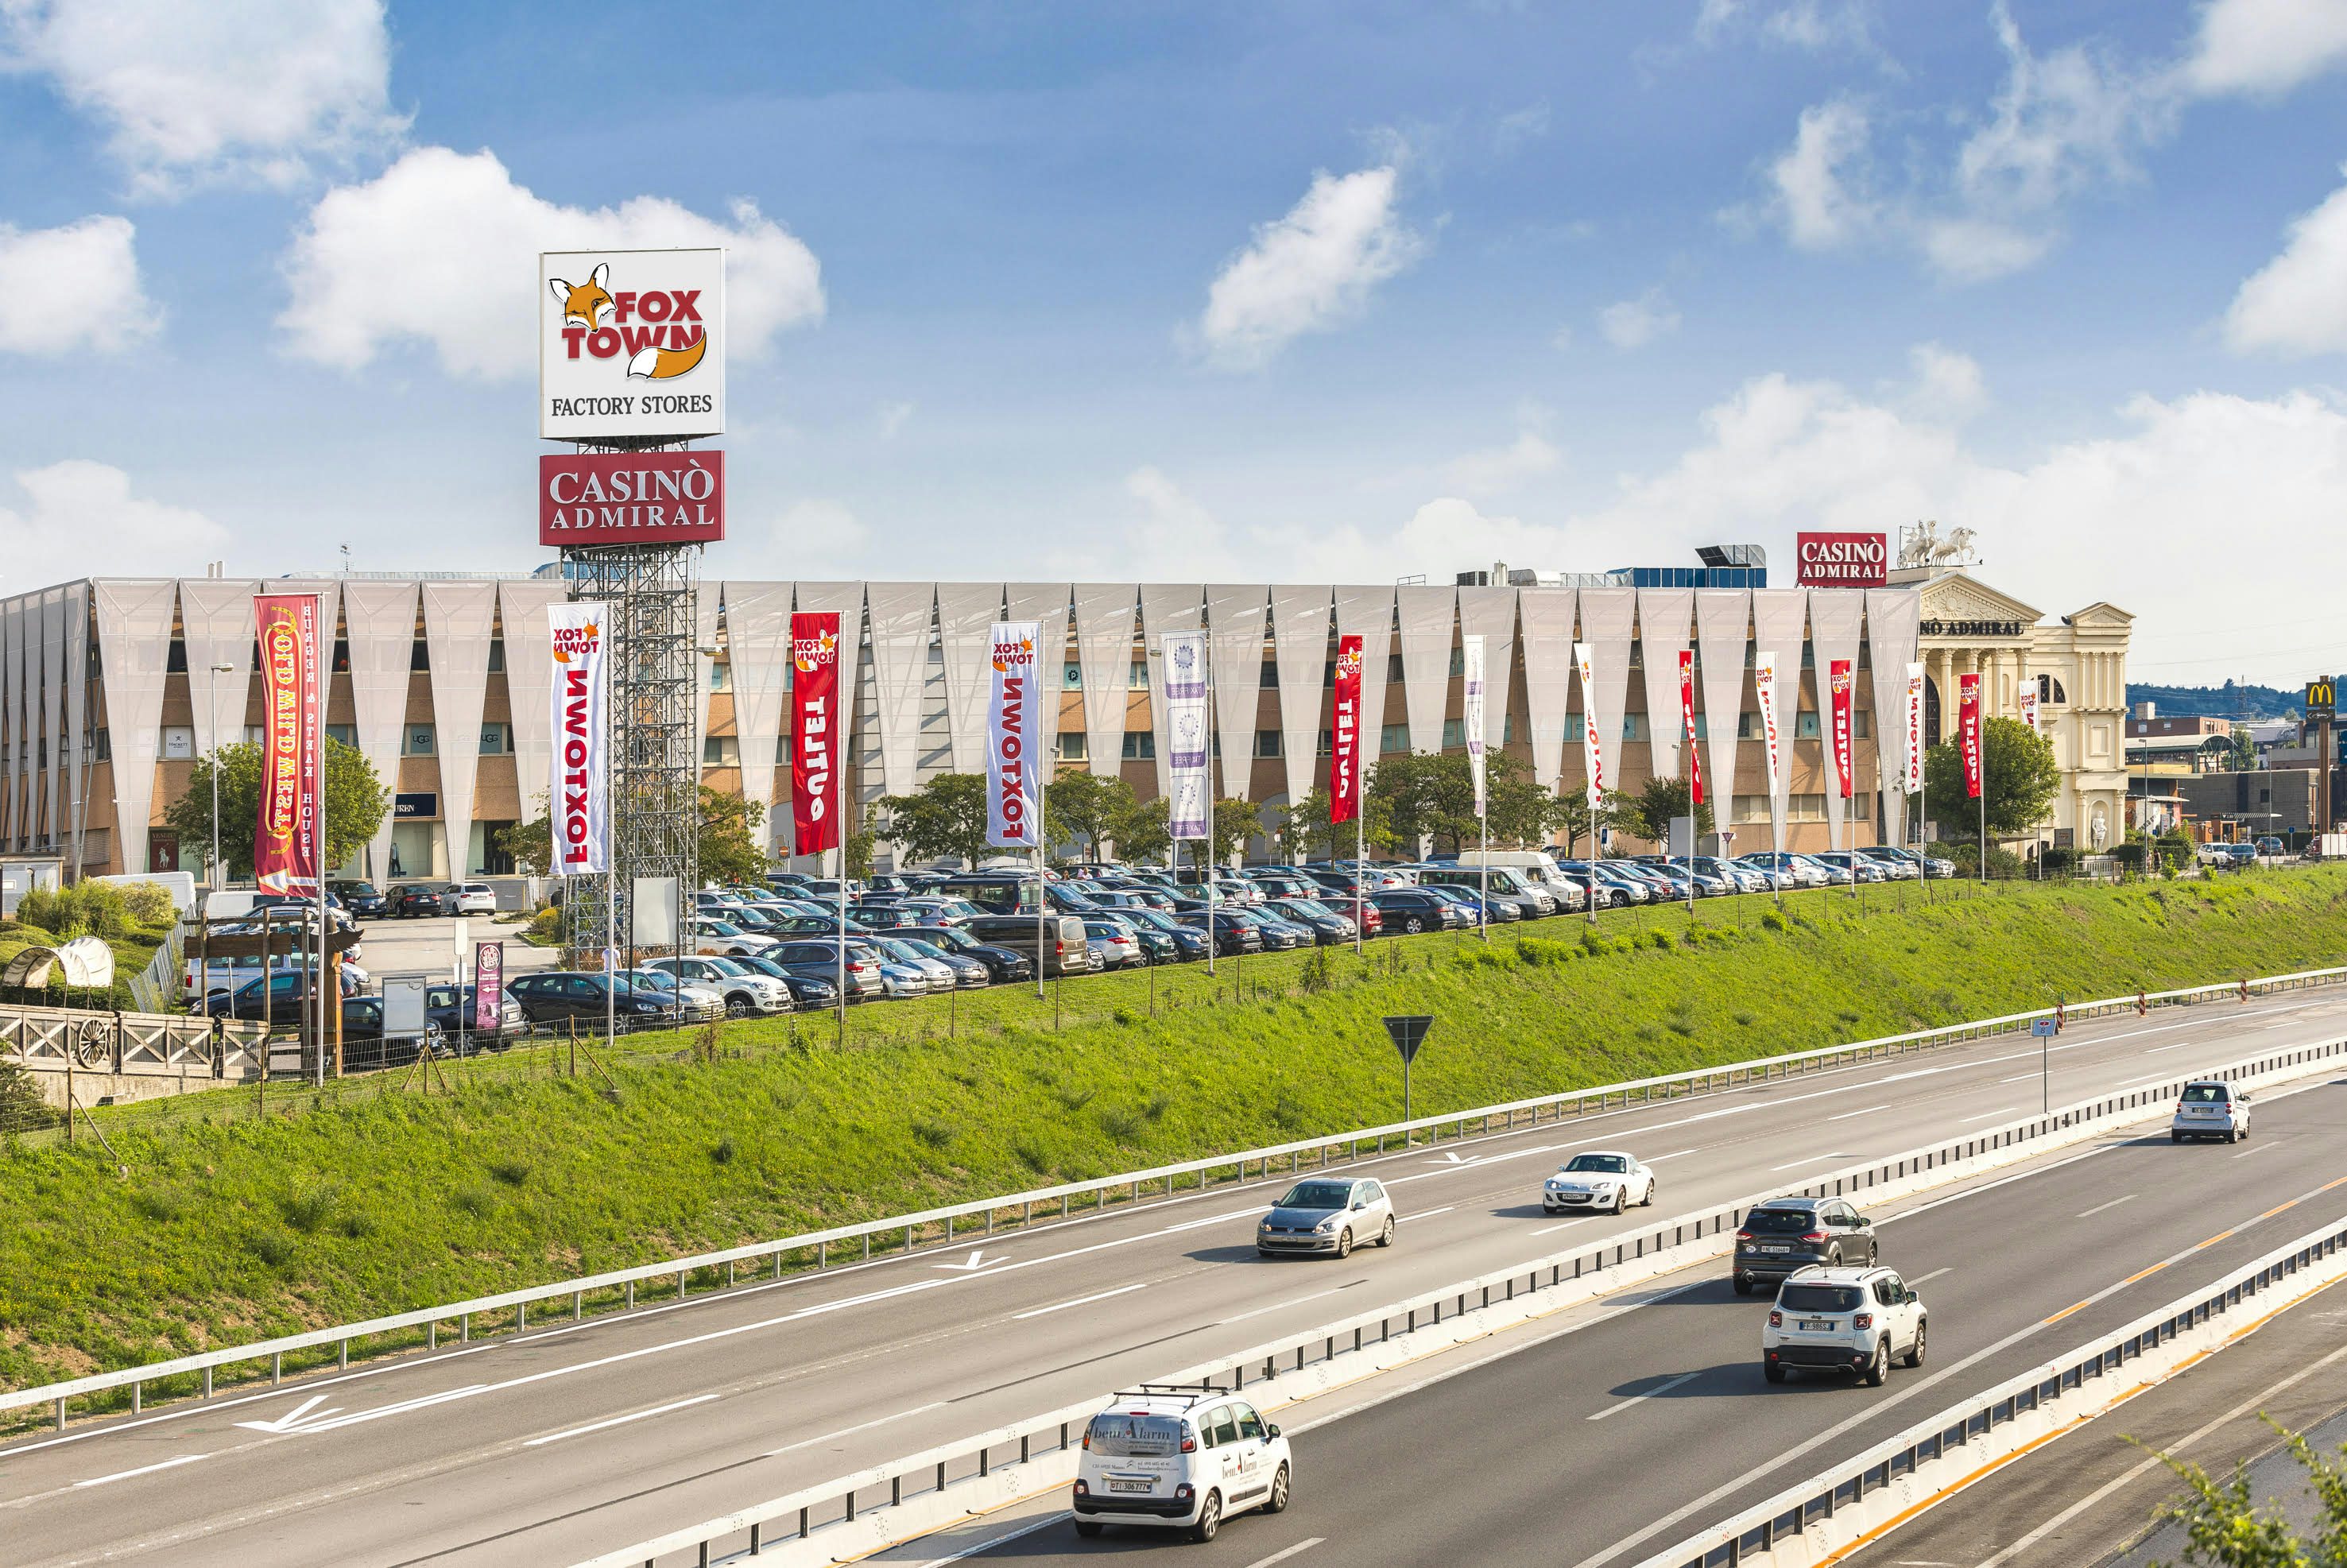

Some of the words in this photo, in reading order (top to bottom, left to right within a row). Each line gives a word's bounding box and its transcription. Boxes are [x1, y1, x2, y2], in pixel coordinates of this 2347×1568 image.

[614, 290, 703, 323] FOX
[561, 324, 703, 360] TOWN
[551, 396, 635, 416] FACTORY
[641, 394, 712, 415] STORES
[549, 459, 715, 505] CASINÒ
[550, 505, 715, 530] ADMIRAL
[1801, 536, 1884, 563] CASINÒ
[1802, 564, 1884, 578] ADMIRAL
[1947, 621, 2024, 635] ADMIRAL
[412, 734, 431, 744] UGG
